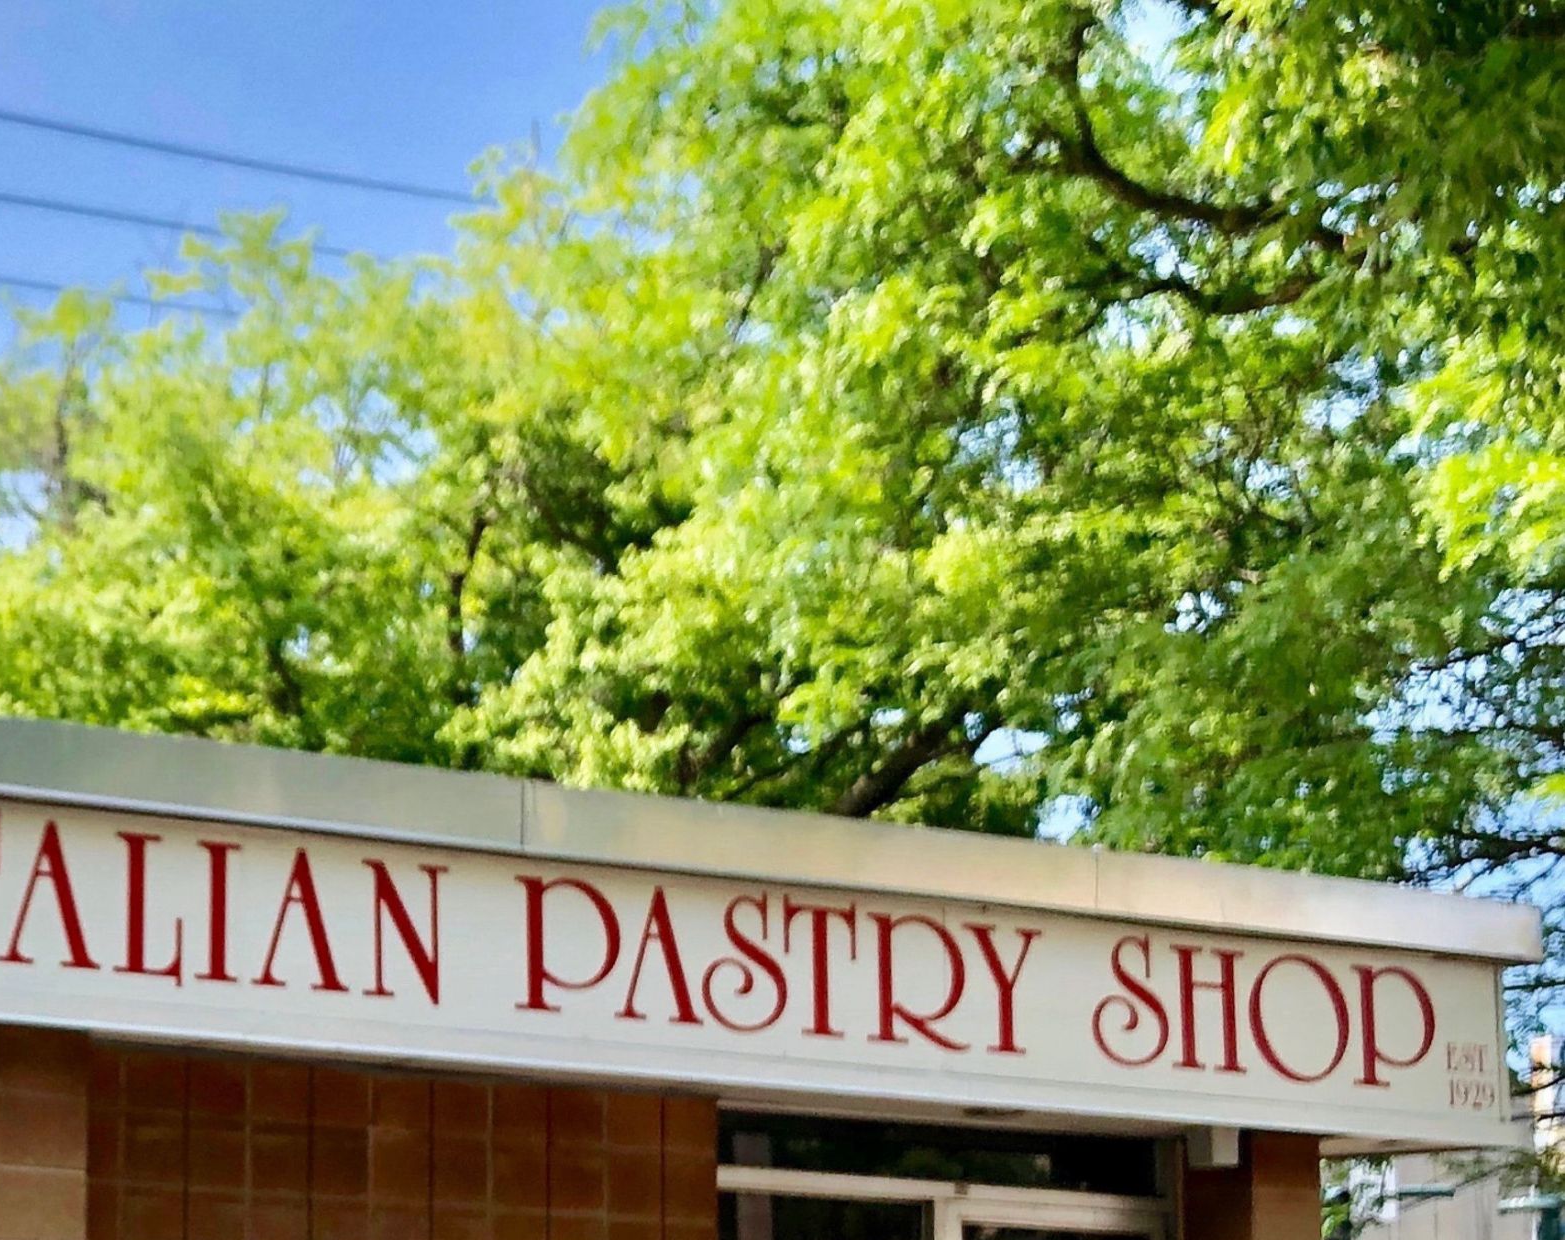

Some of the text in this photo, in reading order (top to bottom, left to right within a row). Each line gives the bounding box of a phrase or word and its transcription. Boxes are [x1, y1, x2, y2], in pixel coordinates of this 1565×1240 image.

[515, 874, 1040, 1054] PASTRY
[1092, 933, 1436, 1088] SHOP
[1448, 1079, 1497, 1112] 1929
